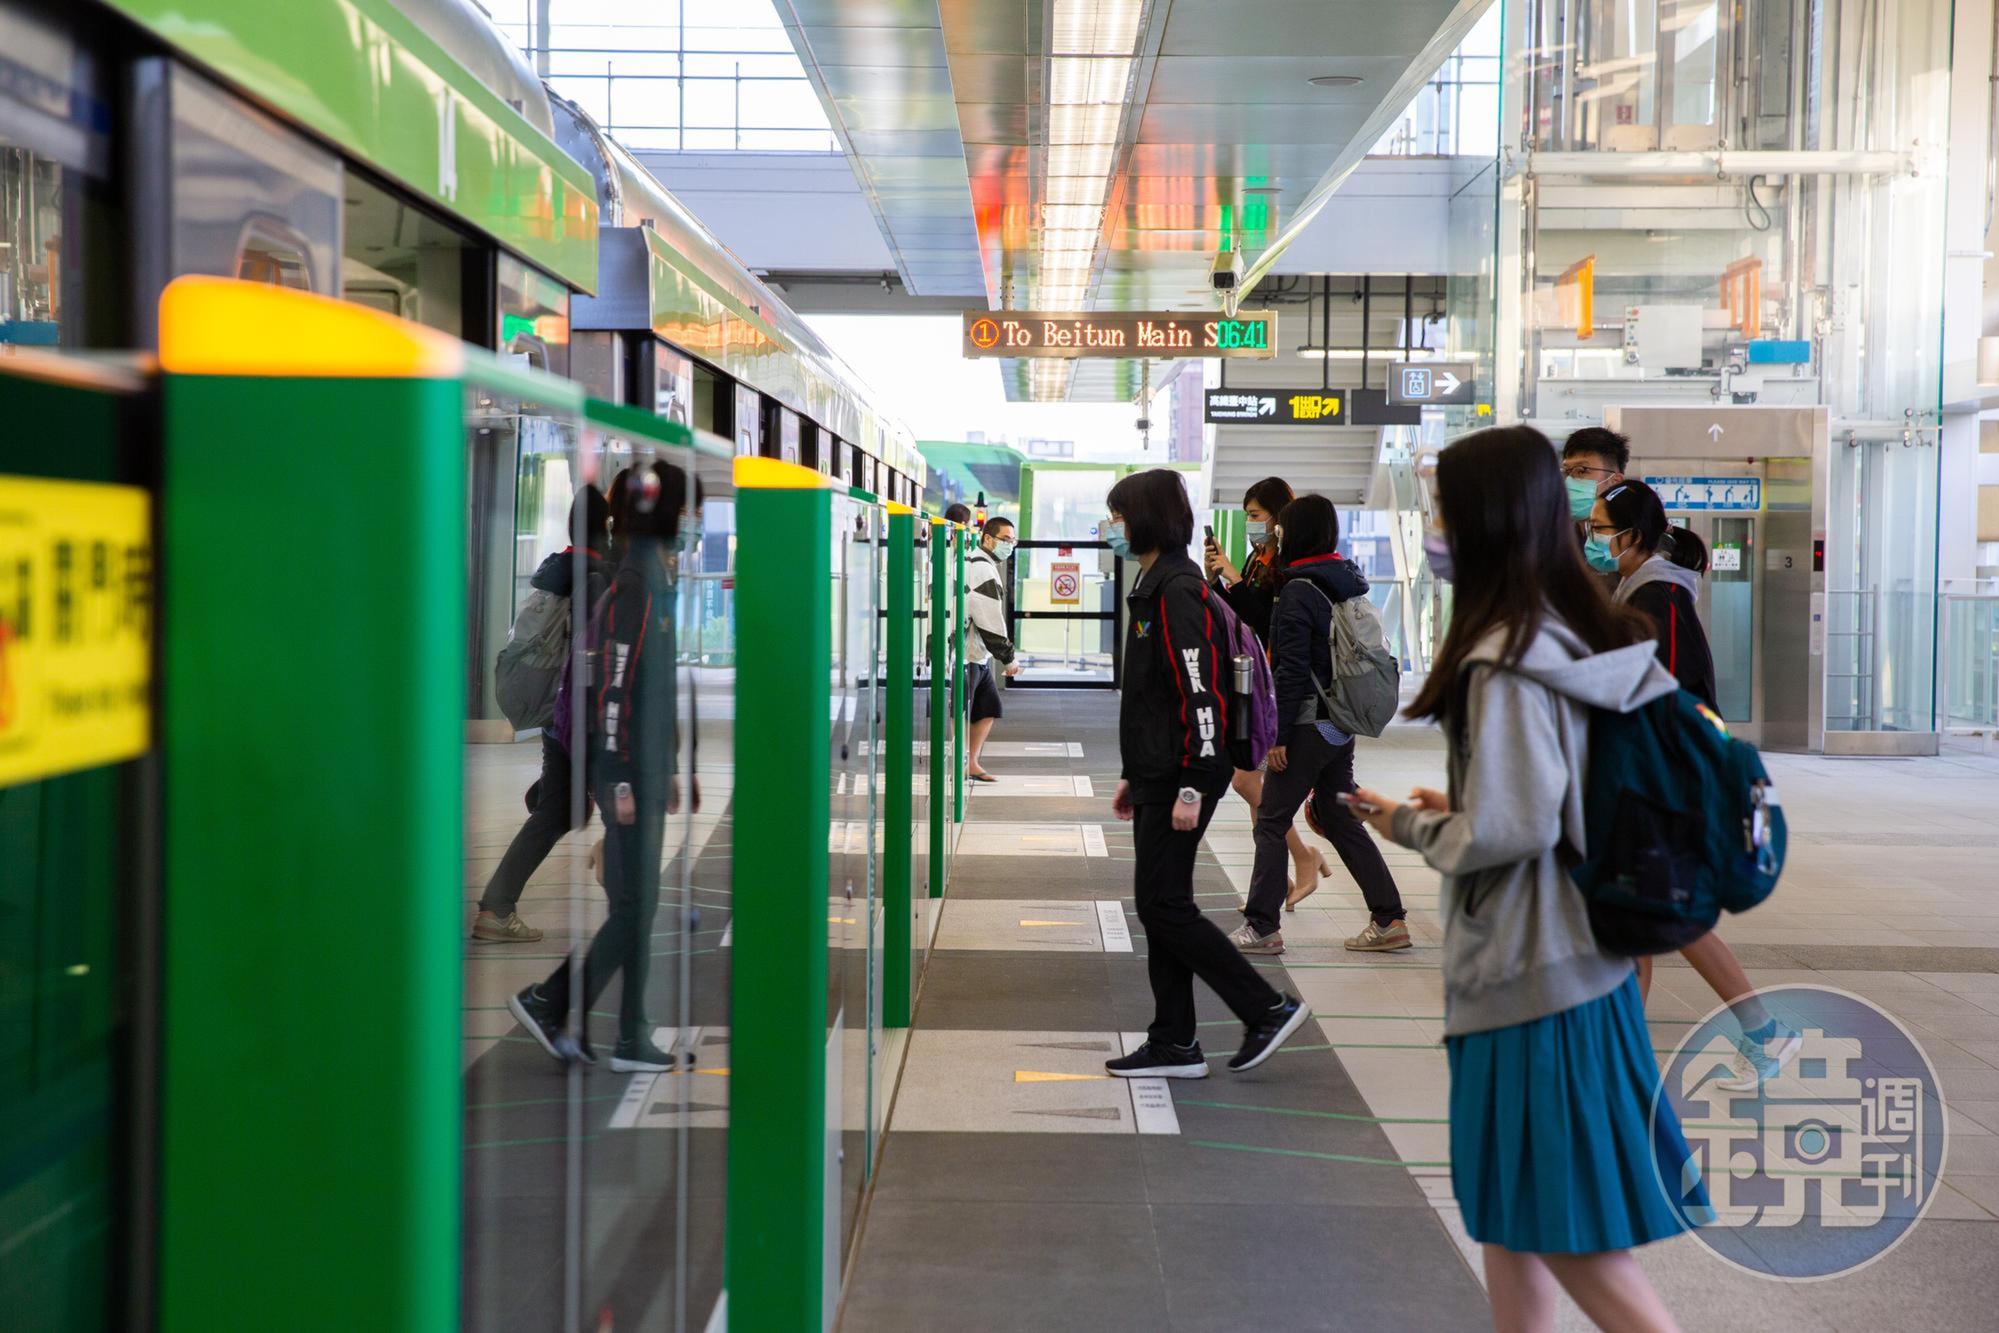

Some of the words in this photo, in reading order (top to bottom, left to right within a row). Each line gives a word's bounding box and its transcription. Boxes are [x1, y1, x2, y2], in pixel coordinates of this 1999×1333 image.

[1003, 321, 1032, 347] To
[1044, 321, 1125, 347] Beitun
[1137, 321, 1192, 347] Main
[1217, 320, 1267, 349] 06:41
[1288, 395, 1300, 419] 1
[1784, 556, 1793, 569] 3
[1196, 706, 1216, 758] HUA
